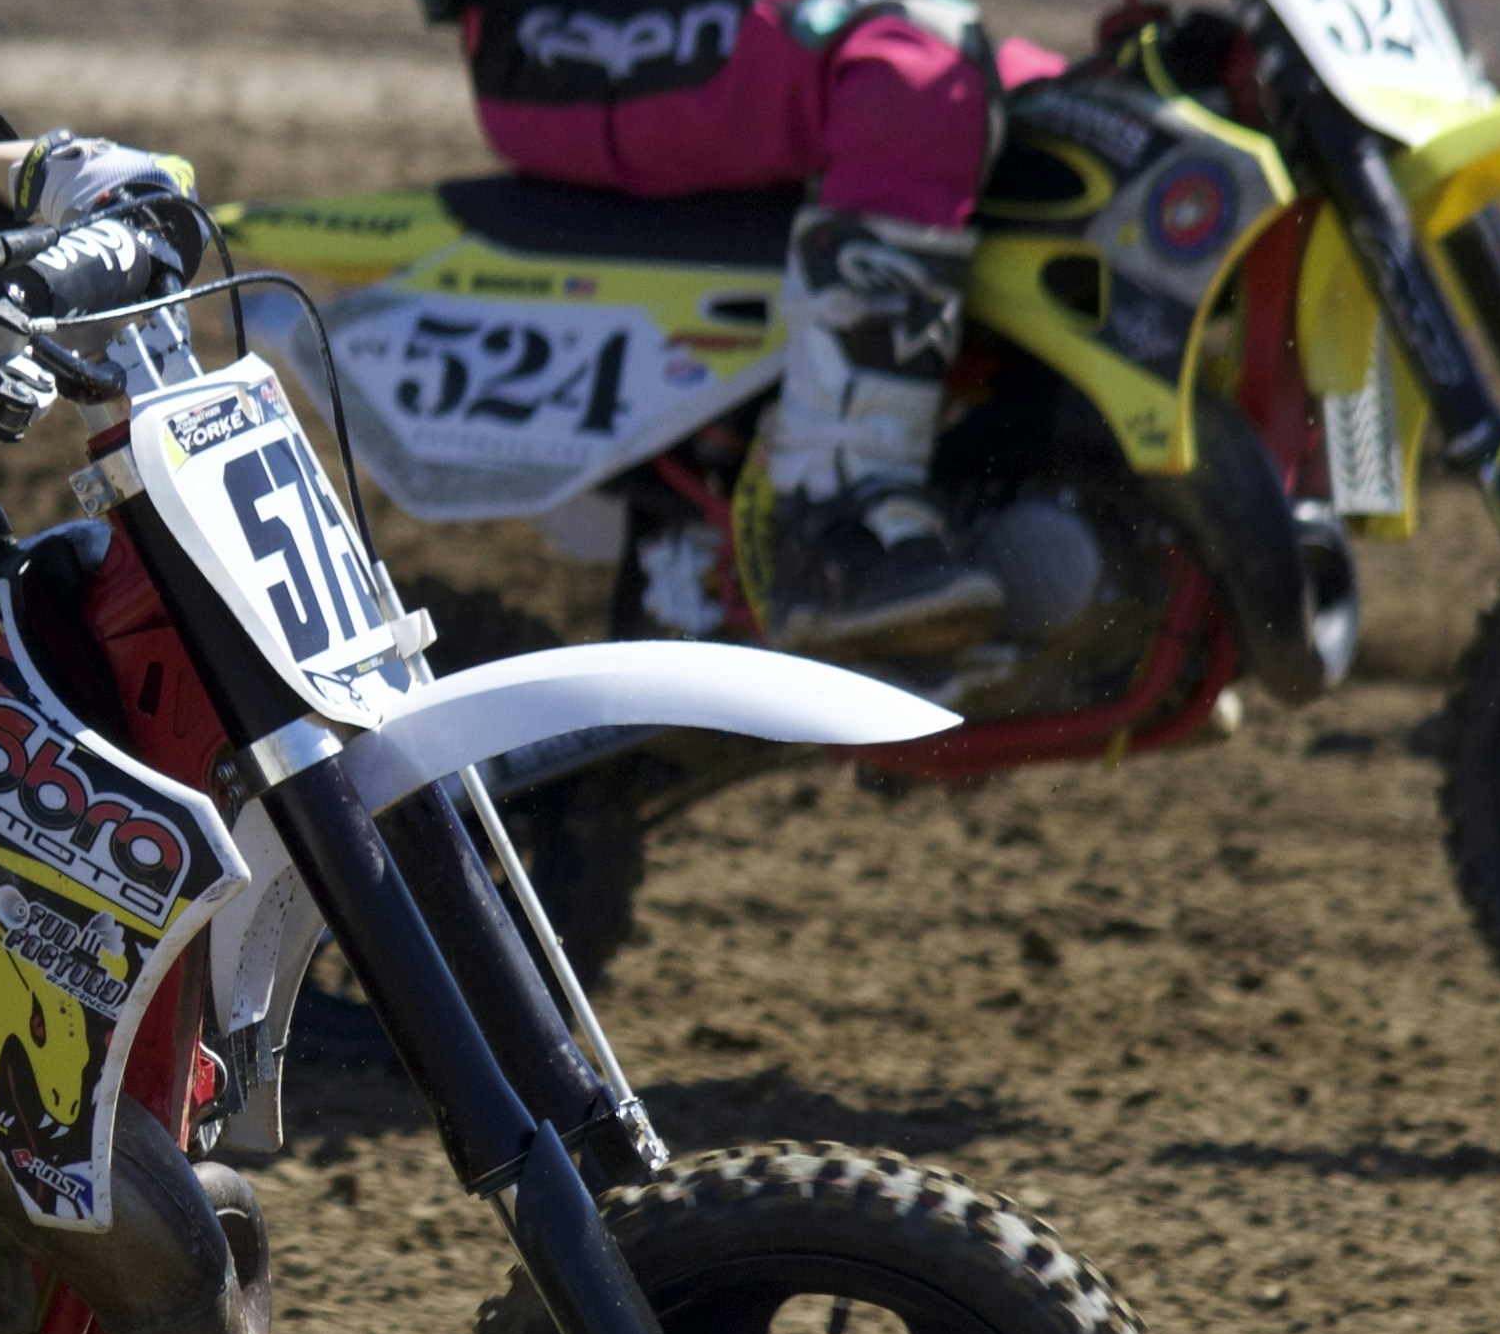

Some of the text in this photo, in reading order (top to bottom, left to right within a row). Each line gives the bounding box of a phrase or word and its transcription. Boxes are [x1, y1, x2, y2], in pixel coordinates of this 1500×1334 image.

[397, 312, 632, 437] 524
[178, 410, 245, 453] YORKE
[26, 903, 78, 953] FUN
[4, 927, 125, 1007] FACTORY
